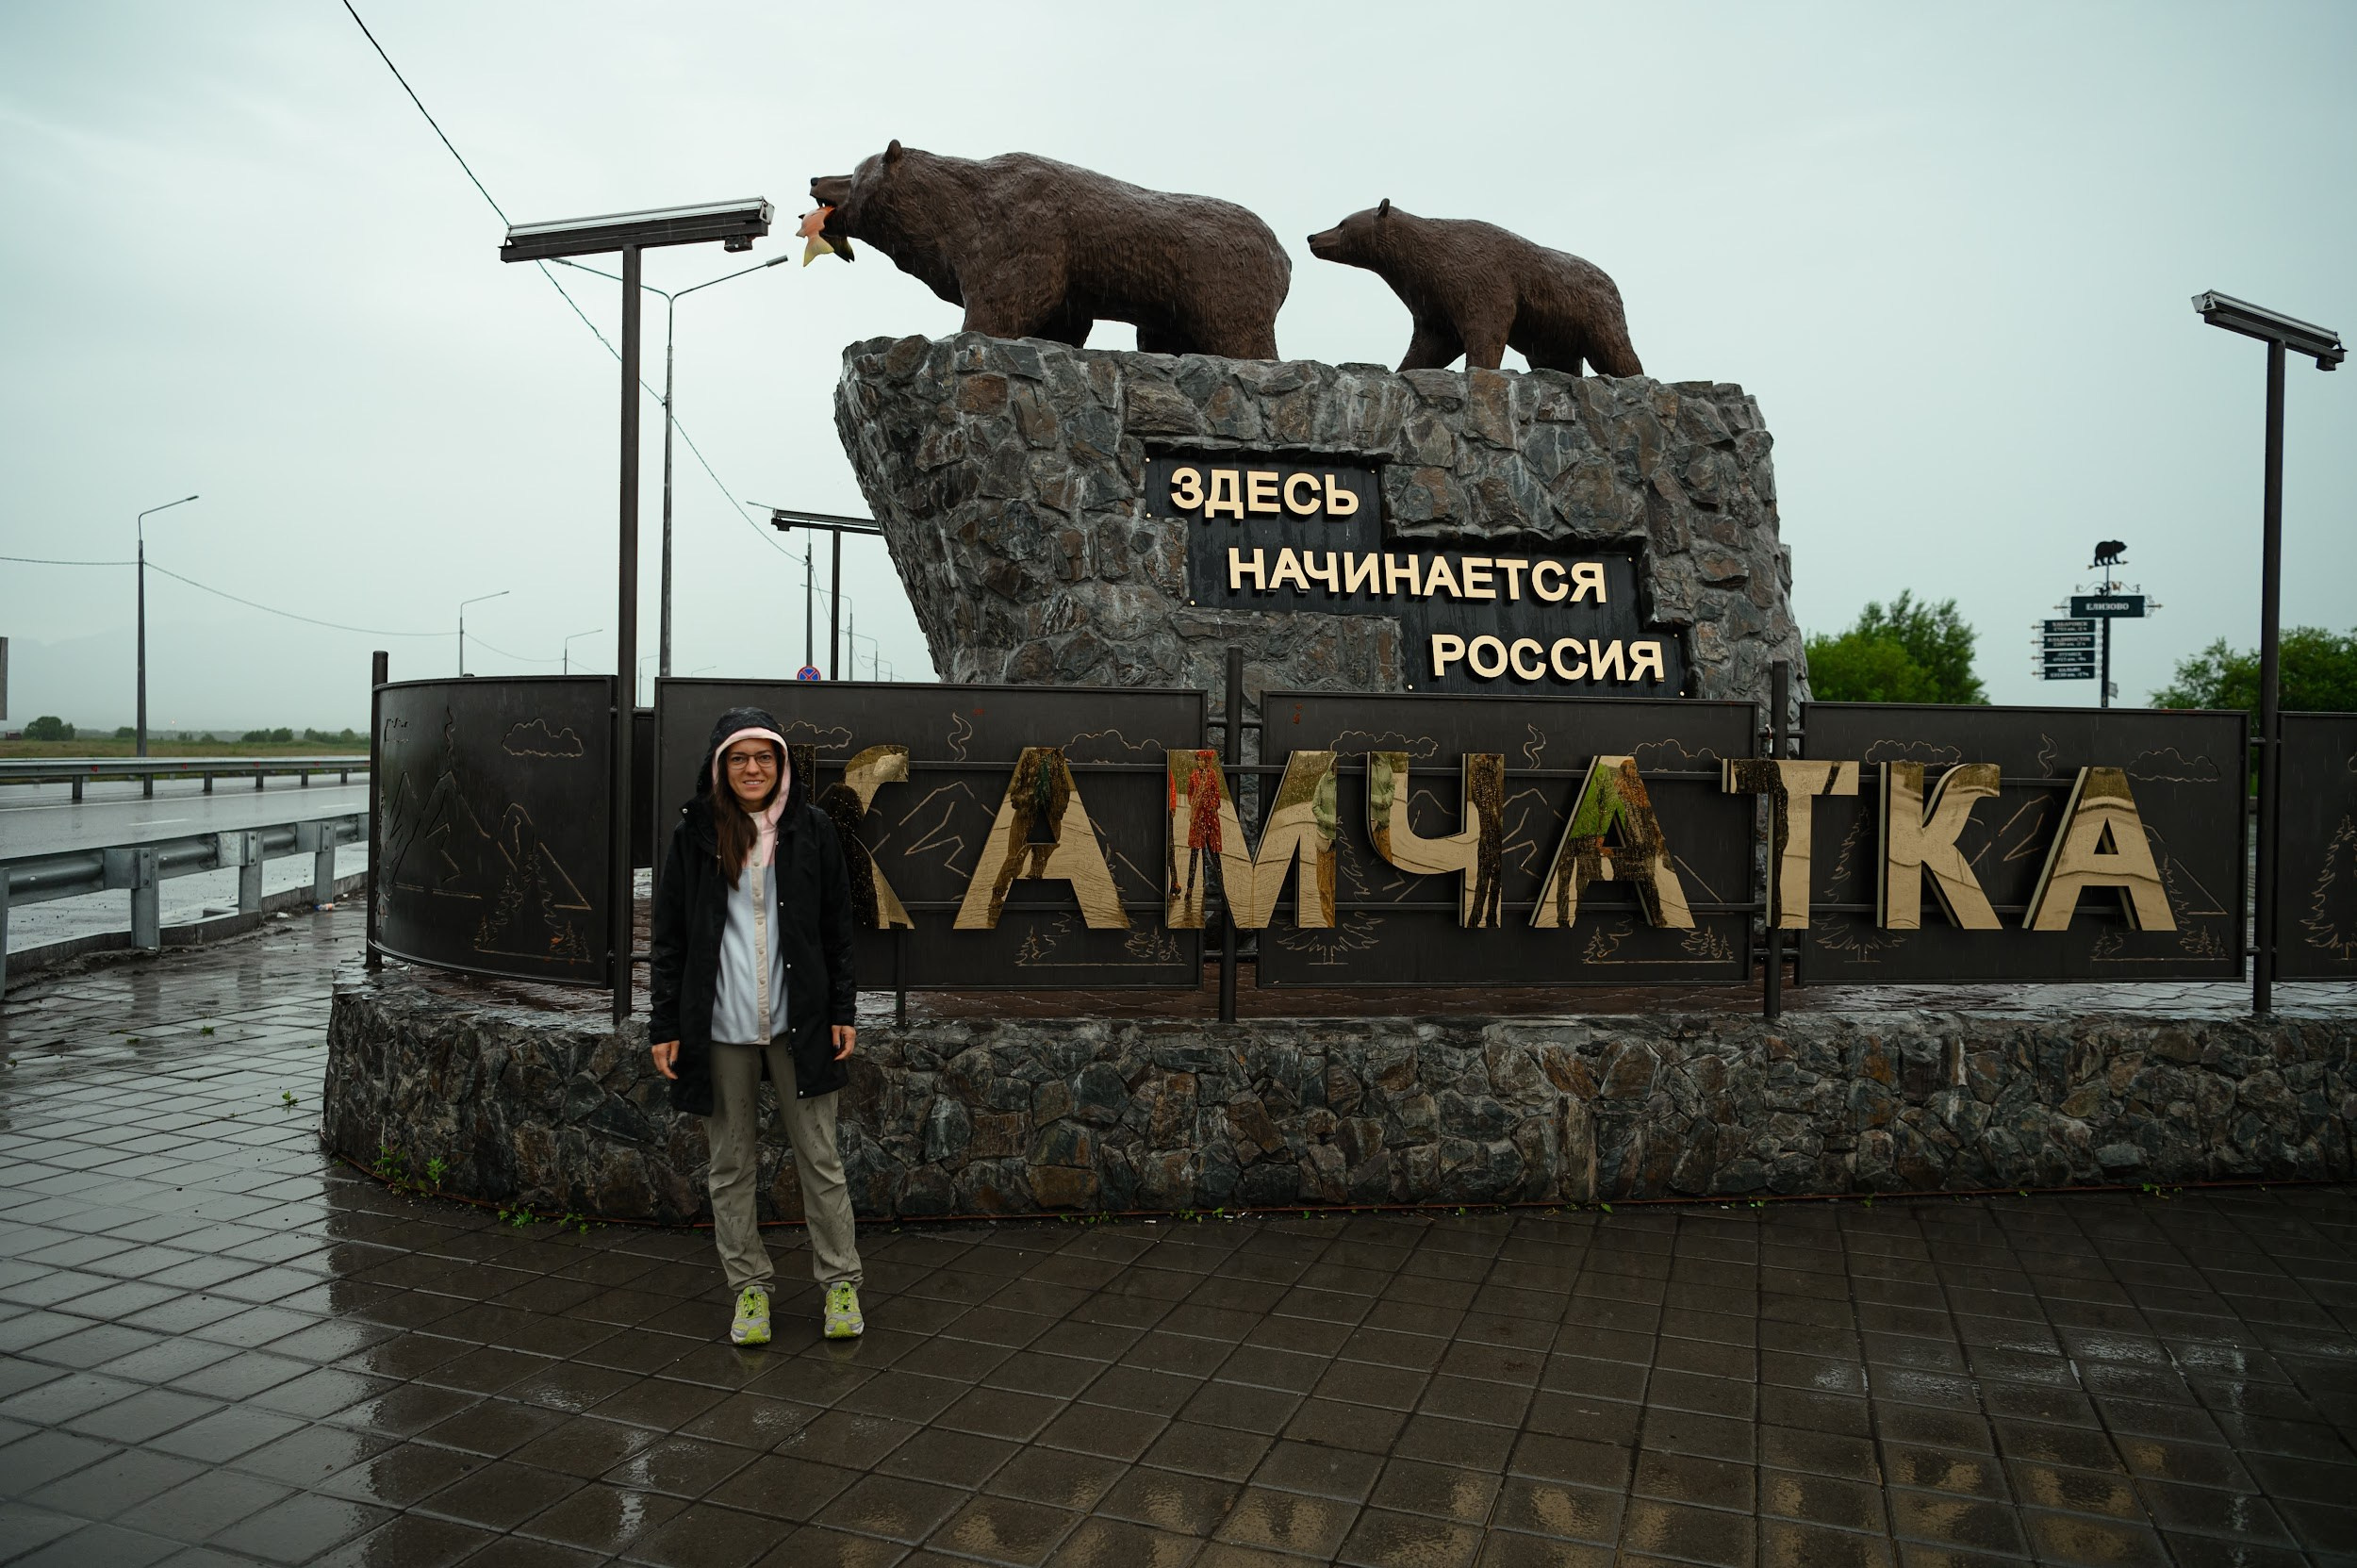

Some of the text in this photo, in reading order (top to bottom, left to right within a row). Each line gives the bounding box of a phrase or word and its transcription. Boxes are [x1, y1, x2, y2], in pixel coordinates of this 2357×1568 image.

[1170, 467, 1360, 520] ЗДЕСЬ
[1228, 548, 1607, 603] НАЧИНАЕТСЯ
[2085, 602, 2130, 611] ЕЛИЗОВО
[1431, 634, 1663, 683] РОССИЯ
